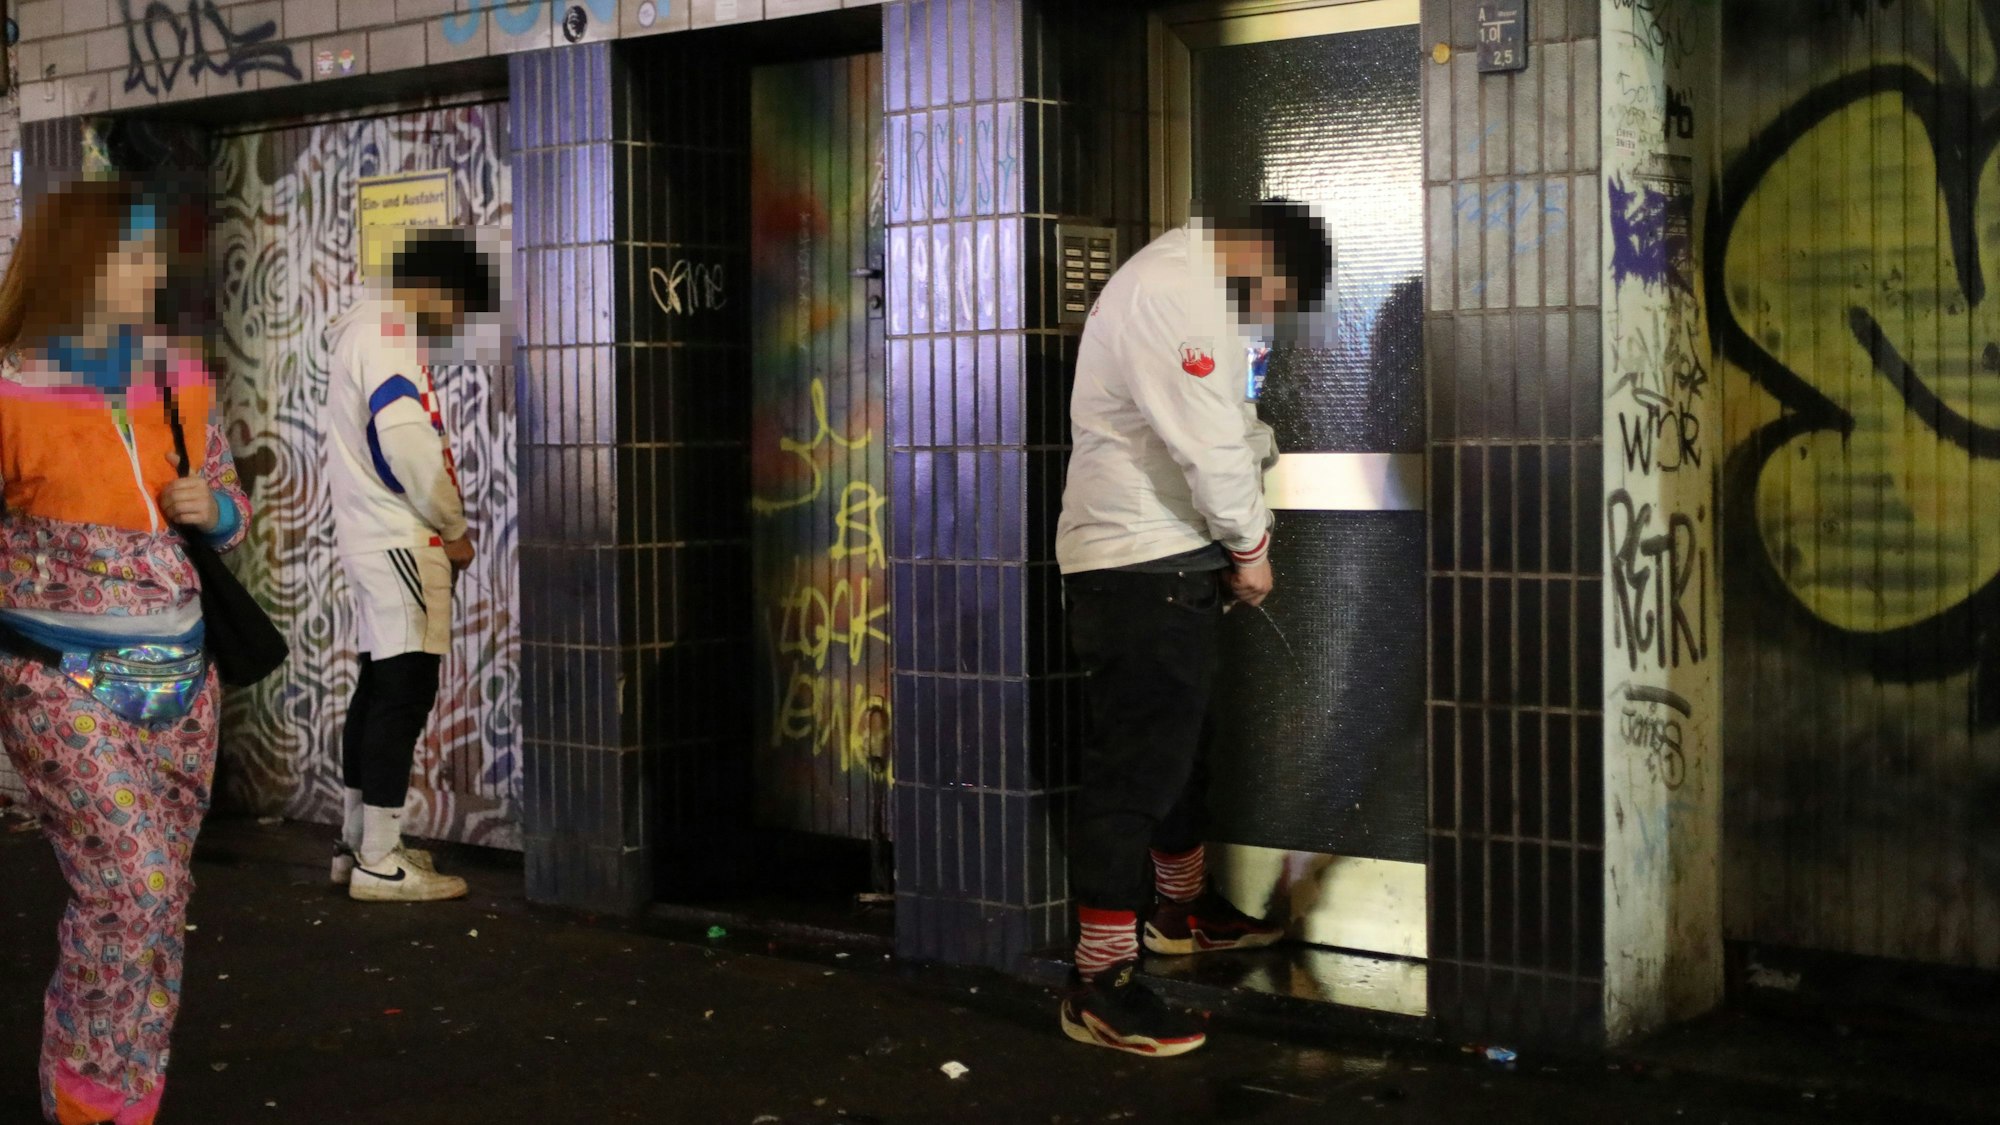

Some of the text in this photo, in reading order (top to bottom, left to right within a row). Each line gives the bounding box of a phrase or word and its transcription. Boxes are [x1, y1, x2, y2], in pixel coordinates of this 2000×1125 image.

[1478, 7, 1486, 22] A
[1480, 27, 1497, 44] 1,0
[1493, 49, 1513, 67] 2,5
[403, 192, 444, 206] Ausfahrt
